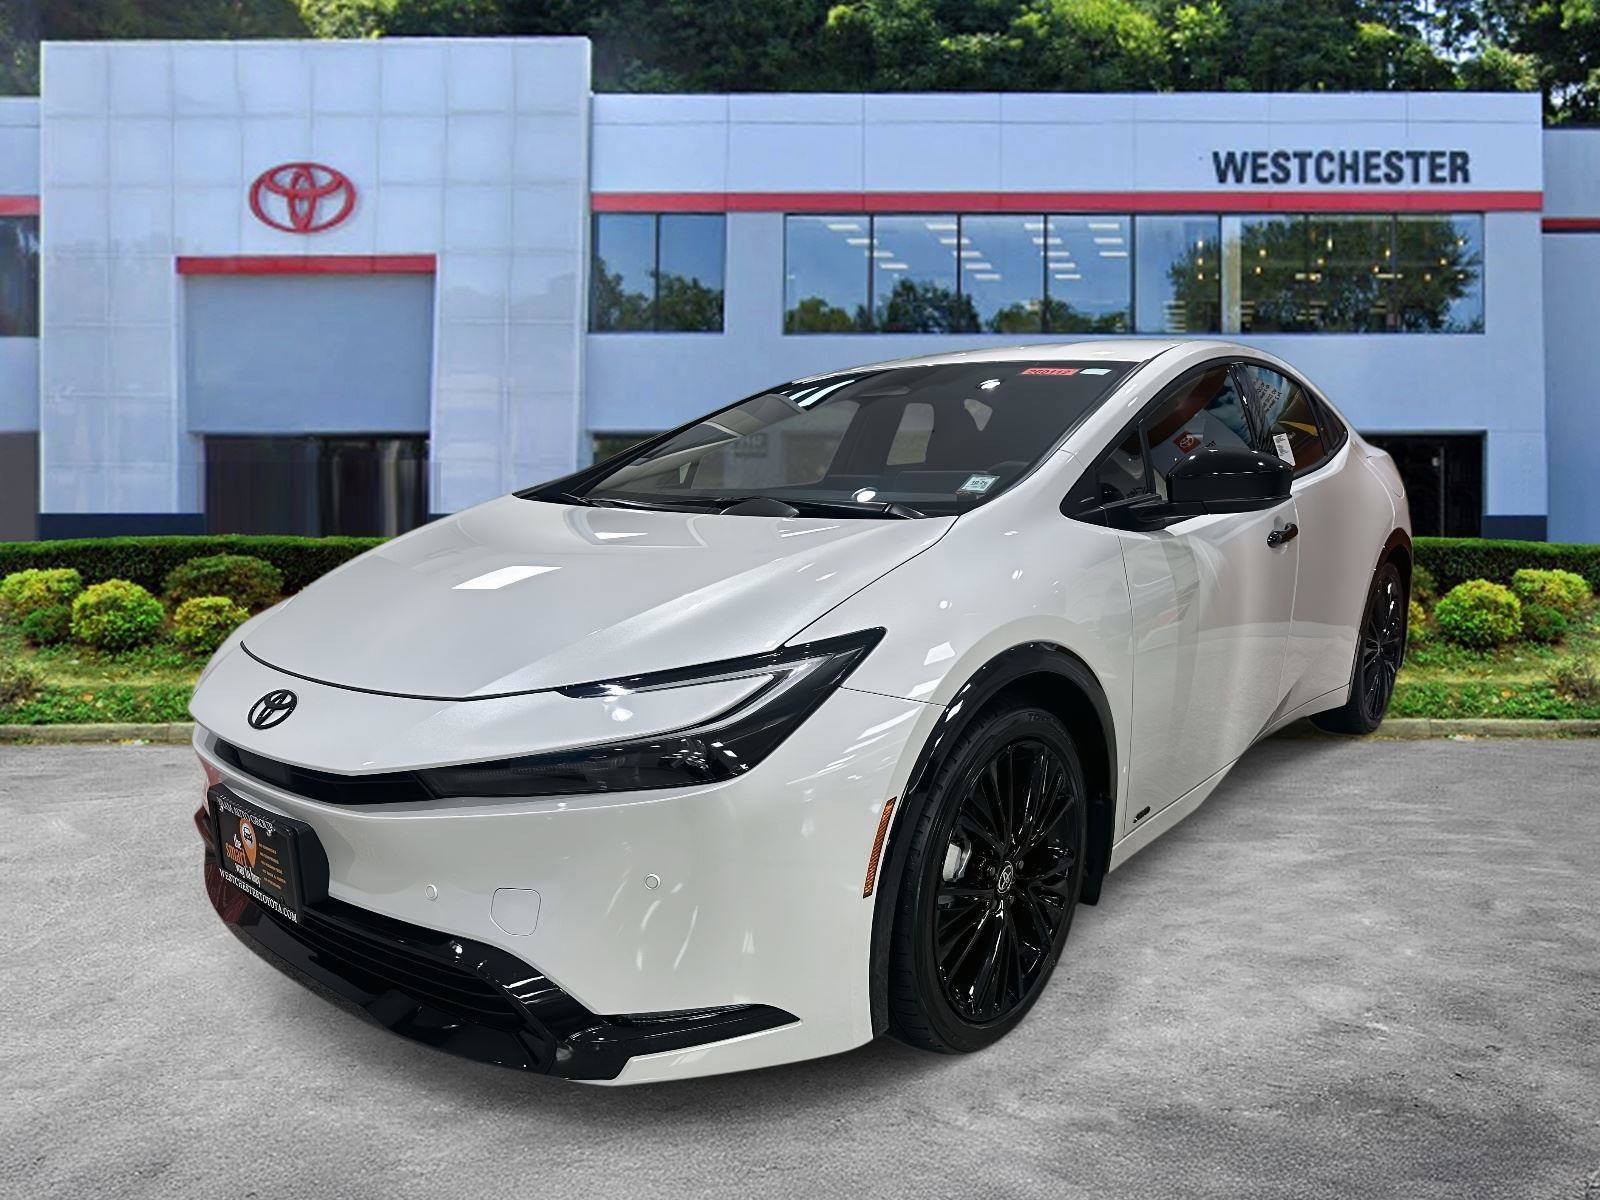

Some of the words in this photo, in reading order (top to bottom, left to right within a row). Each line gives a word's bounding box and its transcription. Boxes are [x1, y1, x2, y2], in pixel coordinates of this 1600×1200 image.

[1211, 150, 1471, 184] WESTCHESTER
[225, 842, 247, 867] smart
[218, 867, 298, 924] WESTCHESTERTOYOTA.COM
